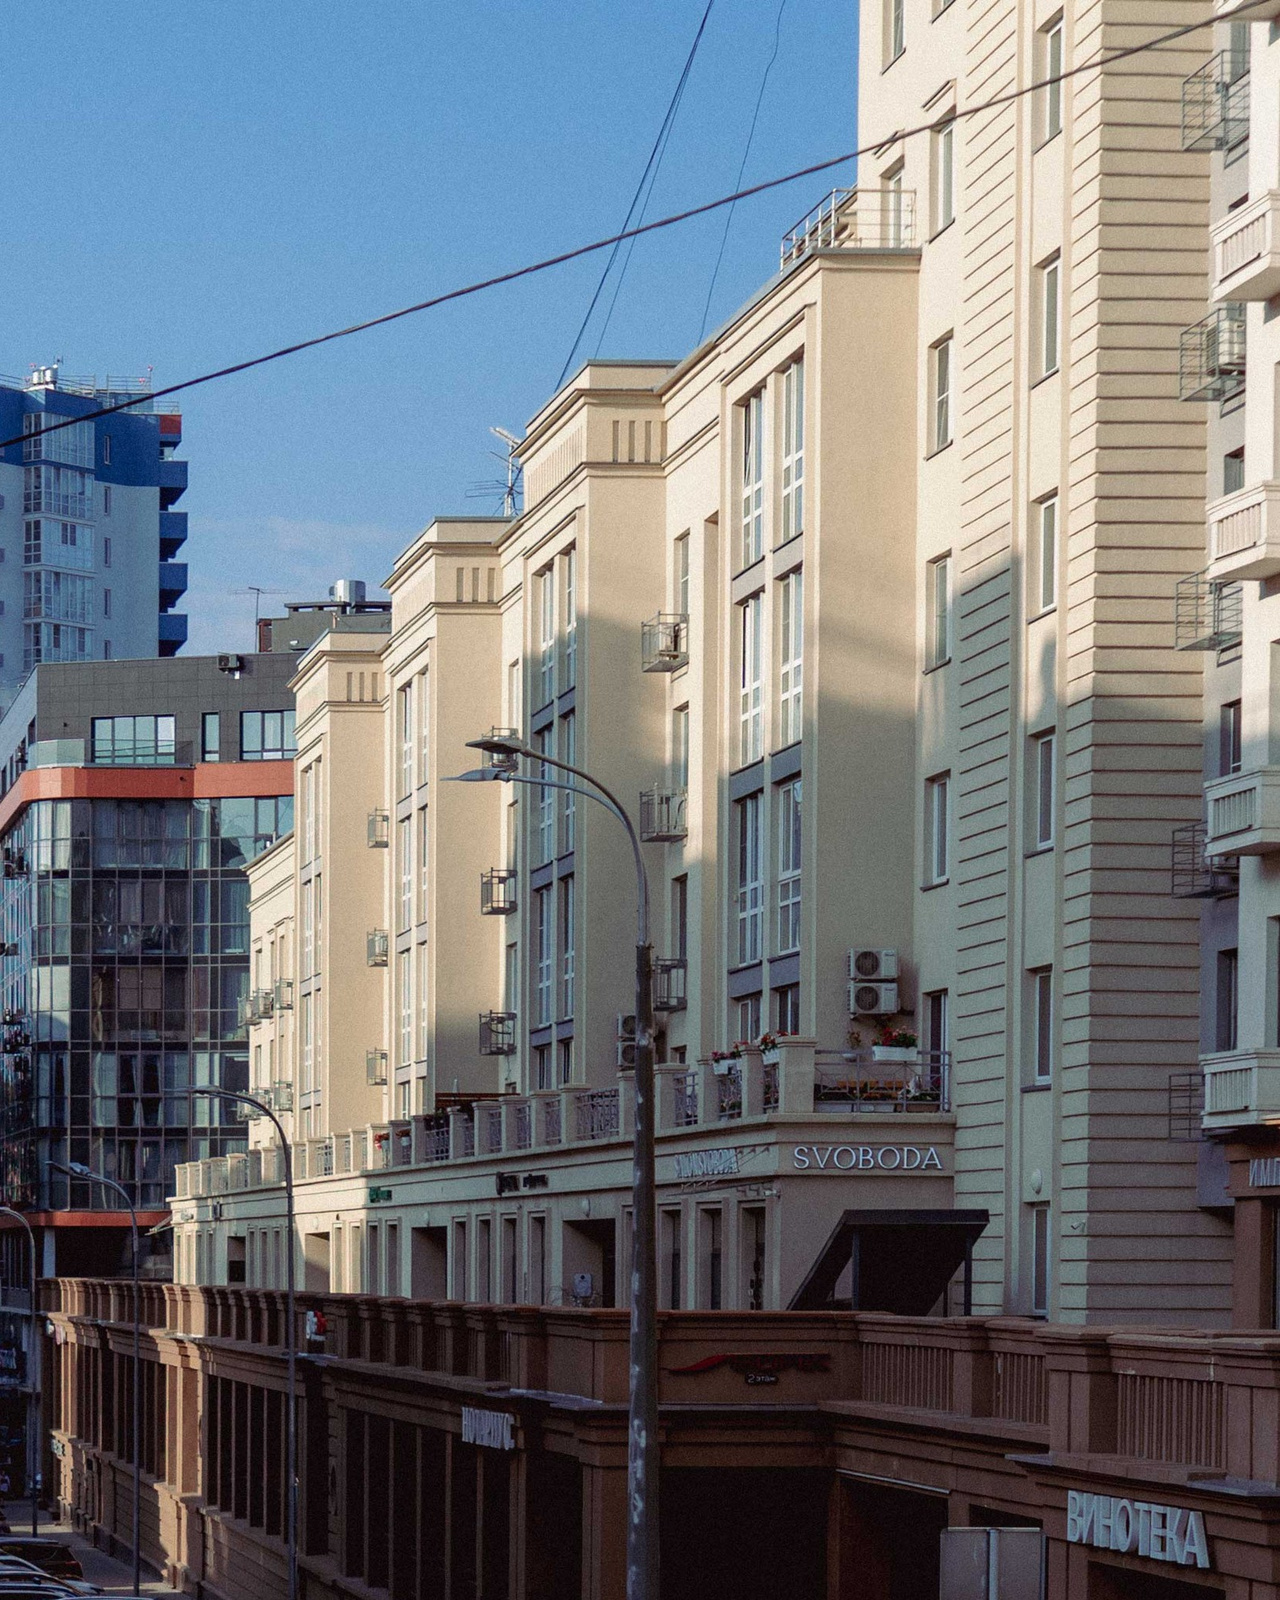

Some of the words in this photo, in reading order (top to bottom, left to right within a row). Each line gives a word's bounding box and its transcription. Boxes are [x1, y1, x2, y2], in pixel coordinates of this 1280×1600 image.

[793, 1146, 943, 1170] SVOBODA
[747, 1373, 755, 1383] 2
[1066, 1490, 1211, 1569] ВИНОТЕКА
